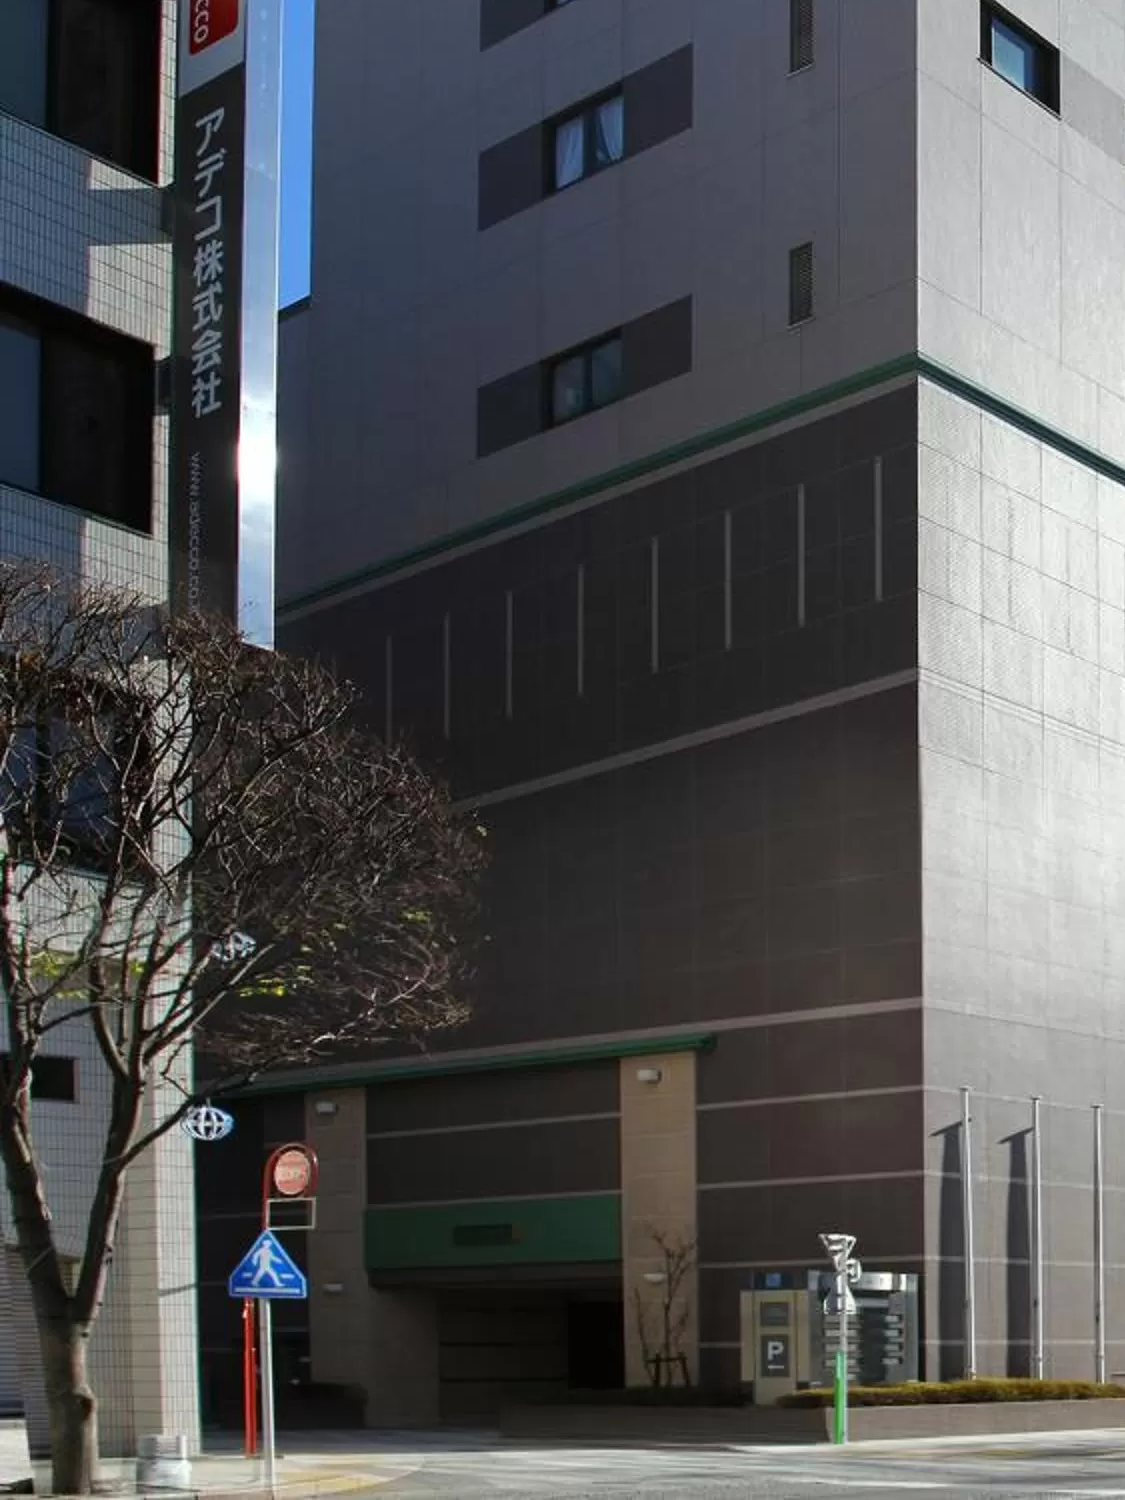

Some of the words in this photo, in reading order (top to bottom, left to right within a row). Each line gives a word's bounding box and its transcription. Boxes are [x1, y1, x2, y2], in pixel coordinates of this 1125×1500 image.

[192, 107, 226, 418] アデコ株式会社
[767, 1341, 785, 1361] P
